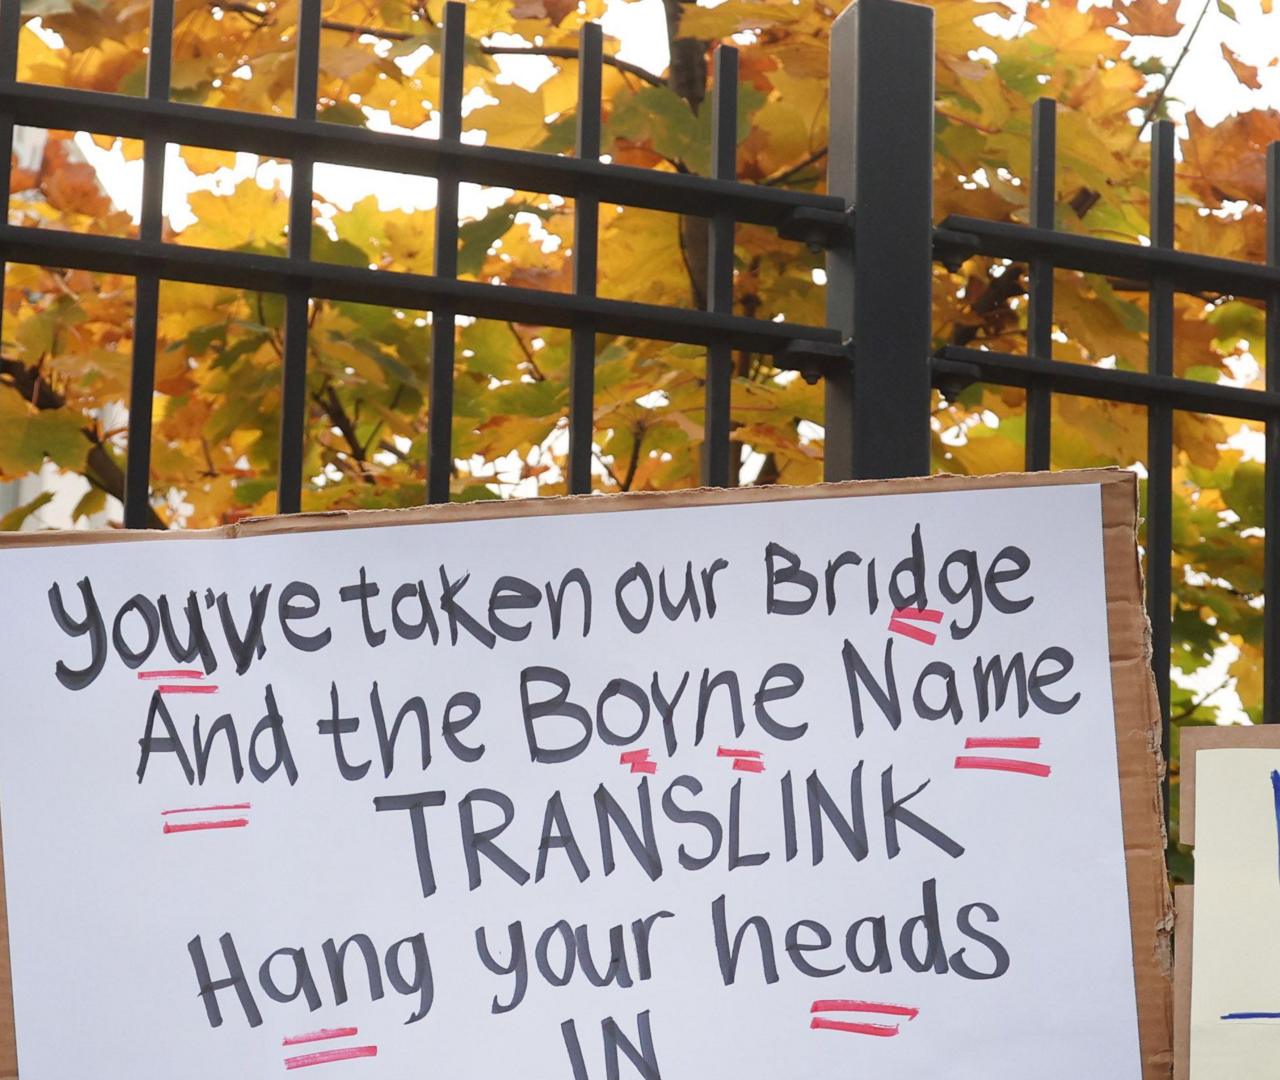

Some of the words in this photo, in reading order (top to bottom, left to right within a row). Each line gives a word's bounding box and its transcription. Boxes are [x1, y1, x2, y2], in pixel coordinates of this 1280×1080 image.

[341, 564, 593, 648] taken
[615, 558, 729, 633] our
[763, 523, 1034, 641] Bridge
[137, 684, 298, 785] And
[317, 682, 486, 778] the
[841, 637, 1082, 737] Name
[373, 761, 964, 897] TRANSLINK
[187, 931, 434, 1027] Hang
[477, 910, 675, 1013] your
[713, 879, 1010, 984] heads
